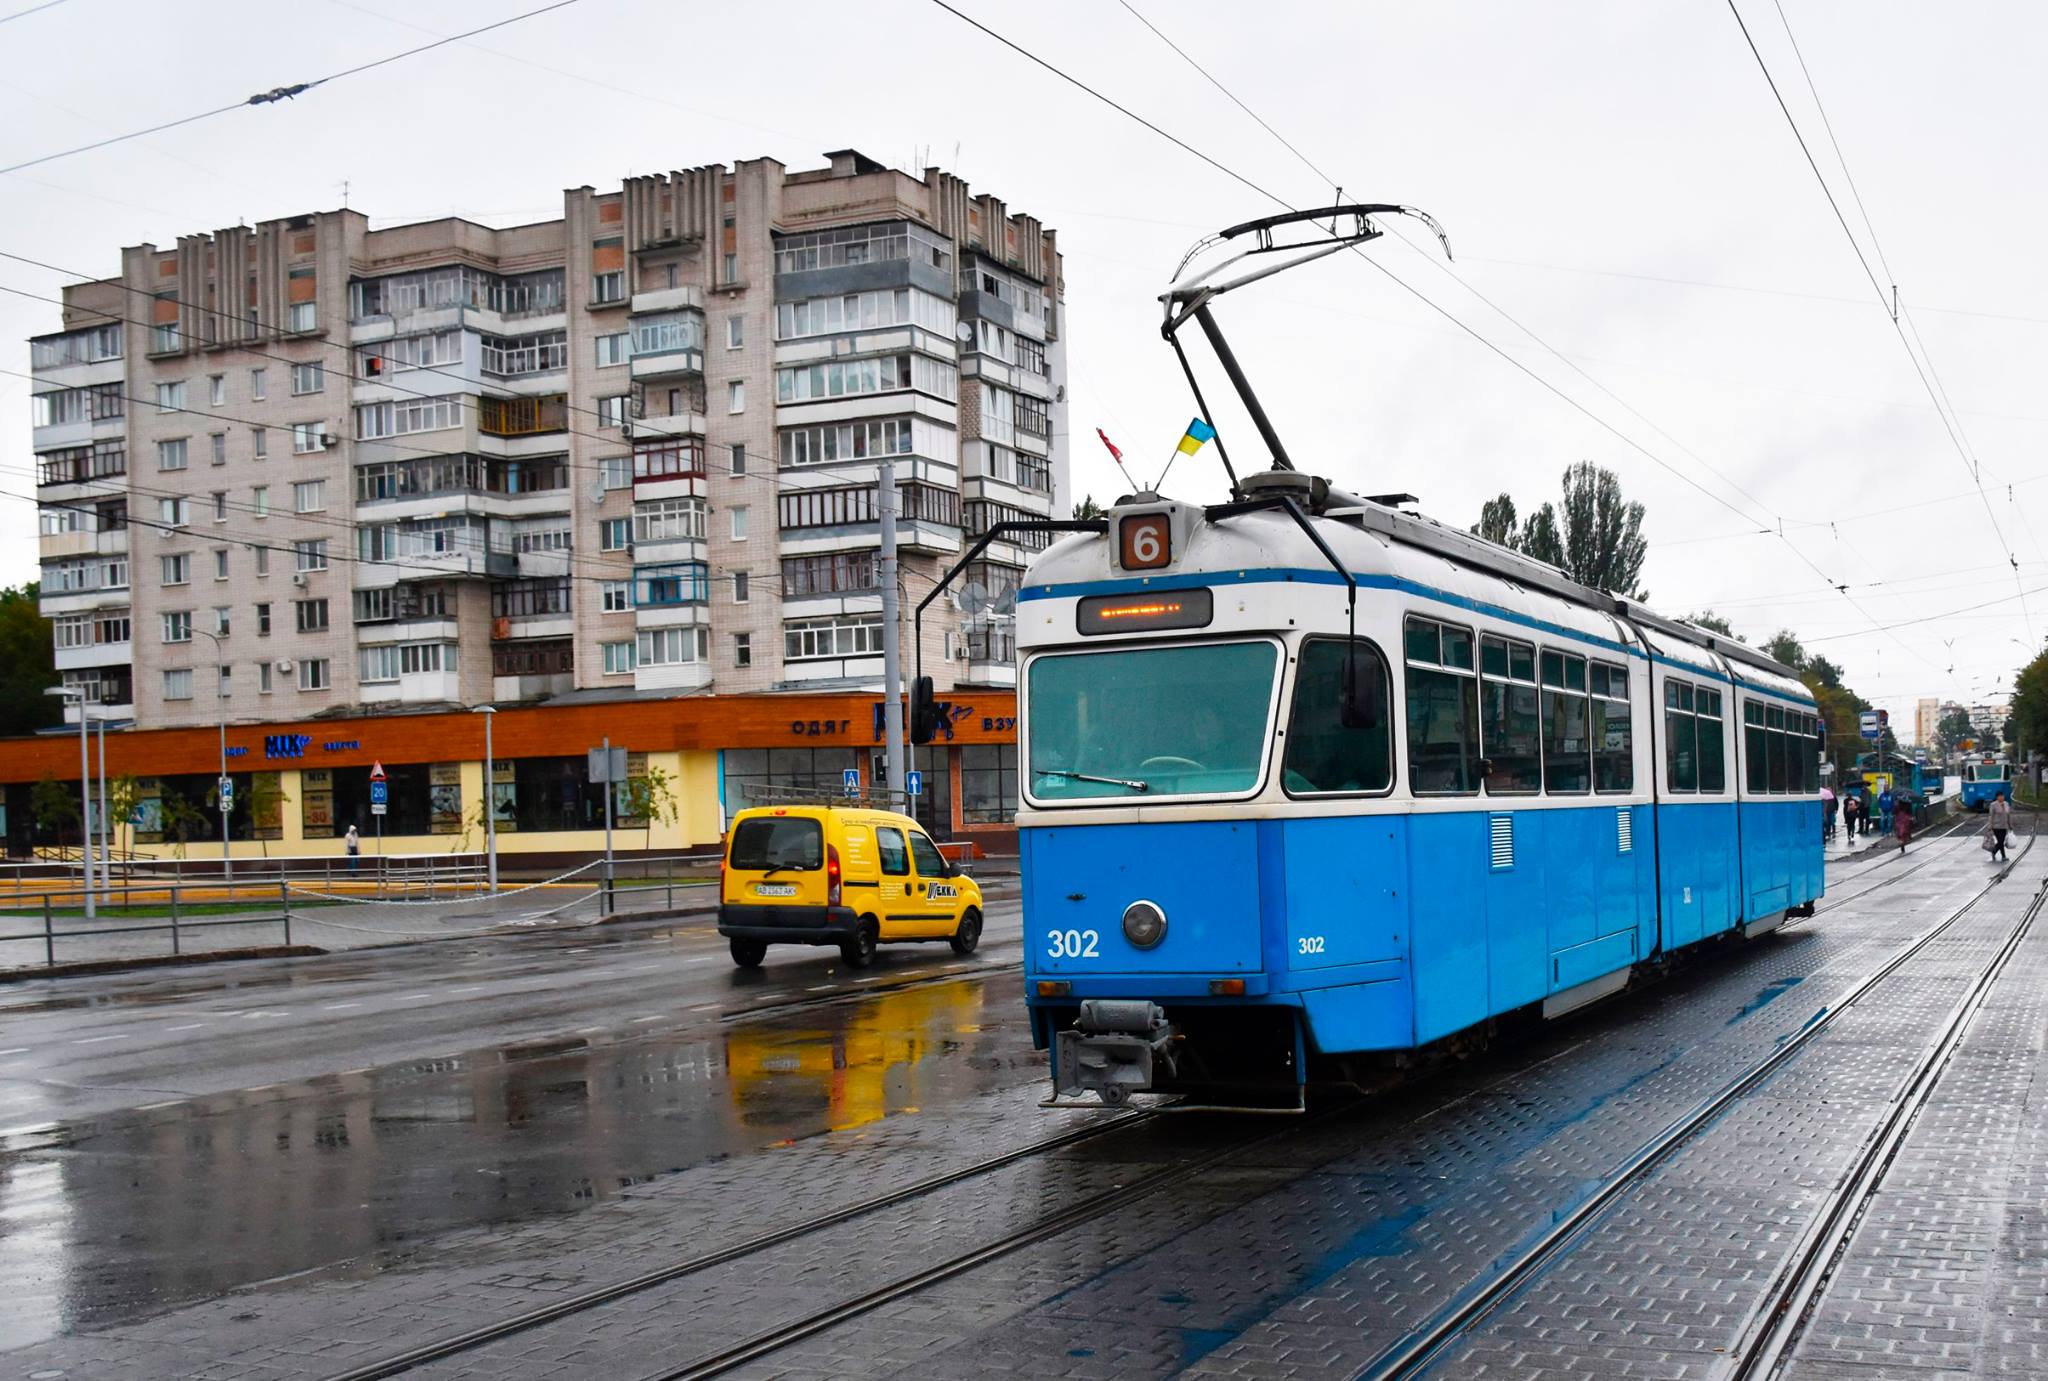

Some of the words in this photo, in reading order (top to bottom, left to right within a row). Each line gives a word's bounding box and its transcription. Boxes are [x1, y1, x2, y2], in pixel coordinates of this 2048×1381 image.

[1134, 526, 1160, 562] 6
[791, 720, 850, 736] ОДЯГ
[374, 787, 385, 798] 20
[1047, 929, 1100, 958] 302
[1298, 936, 1325, 954] 302
